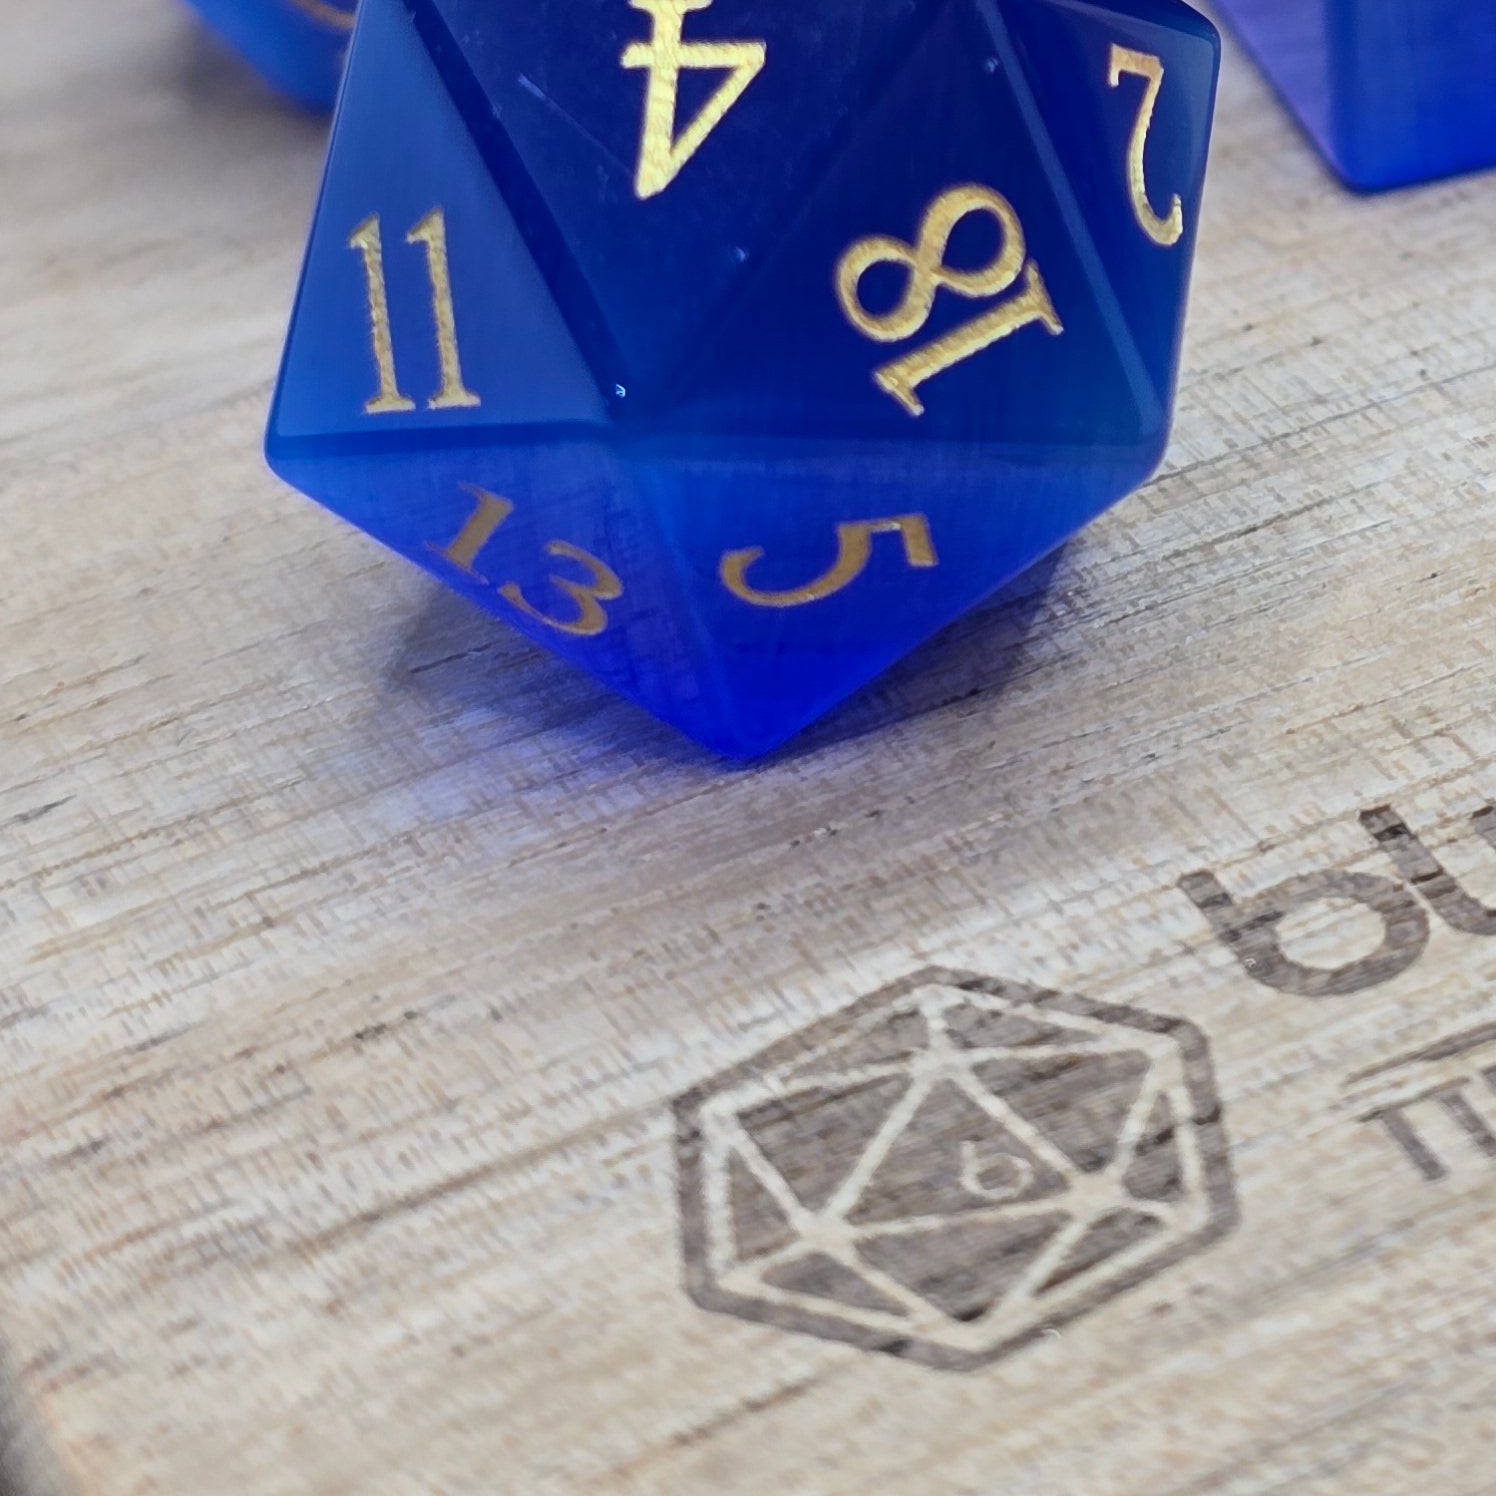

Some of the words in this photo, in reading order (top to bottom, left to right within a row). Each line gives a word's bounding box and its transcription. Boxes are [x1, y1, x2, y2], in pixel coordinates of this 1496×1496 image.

[348, 206, 482, 415] 11
[834, 182, 1066, 418] 18
[422, 478, 626, 638] 13
[719, 514, 940, 608] 5
